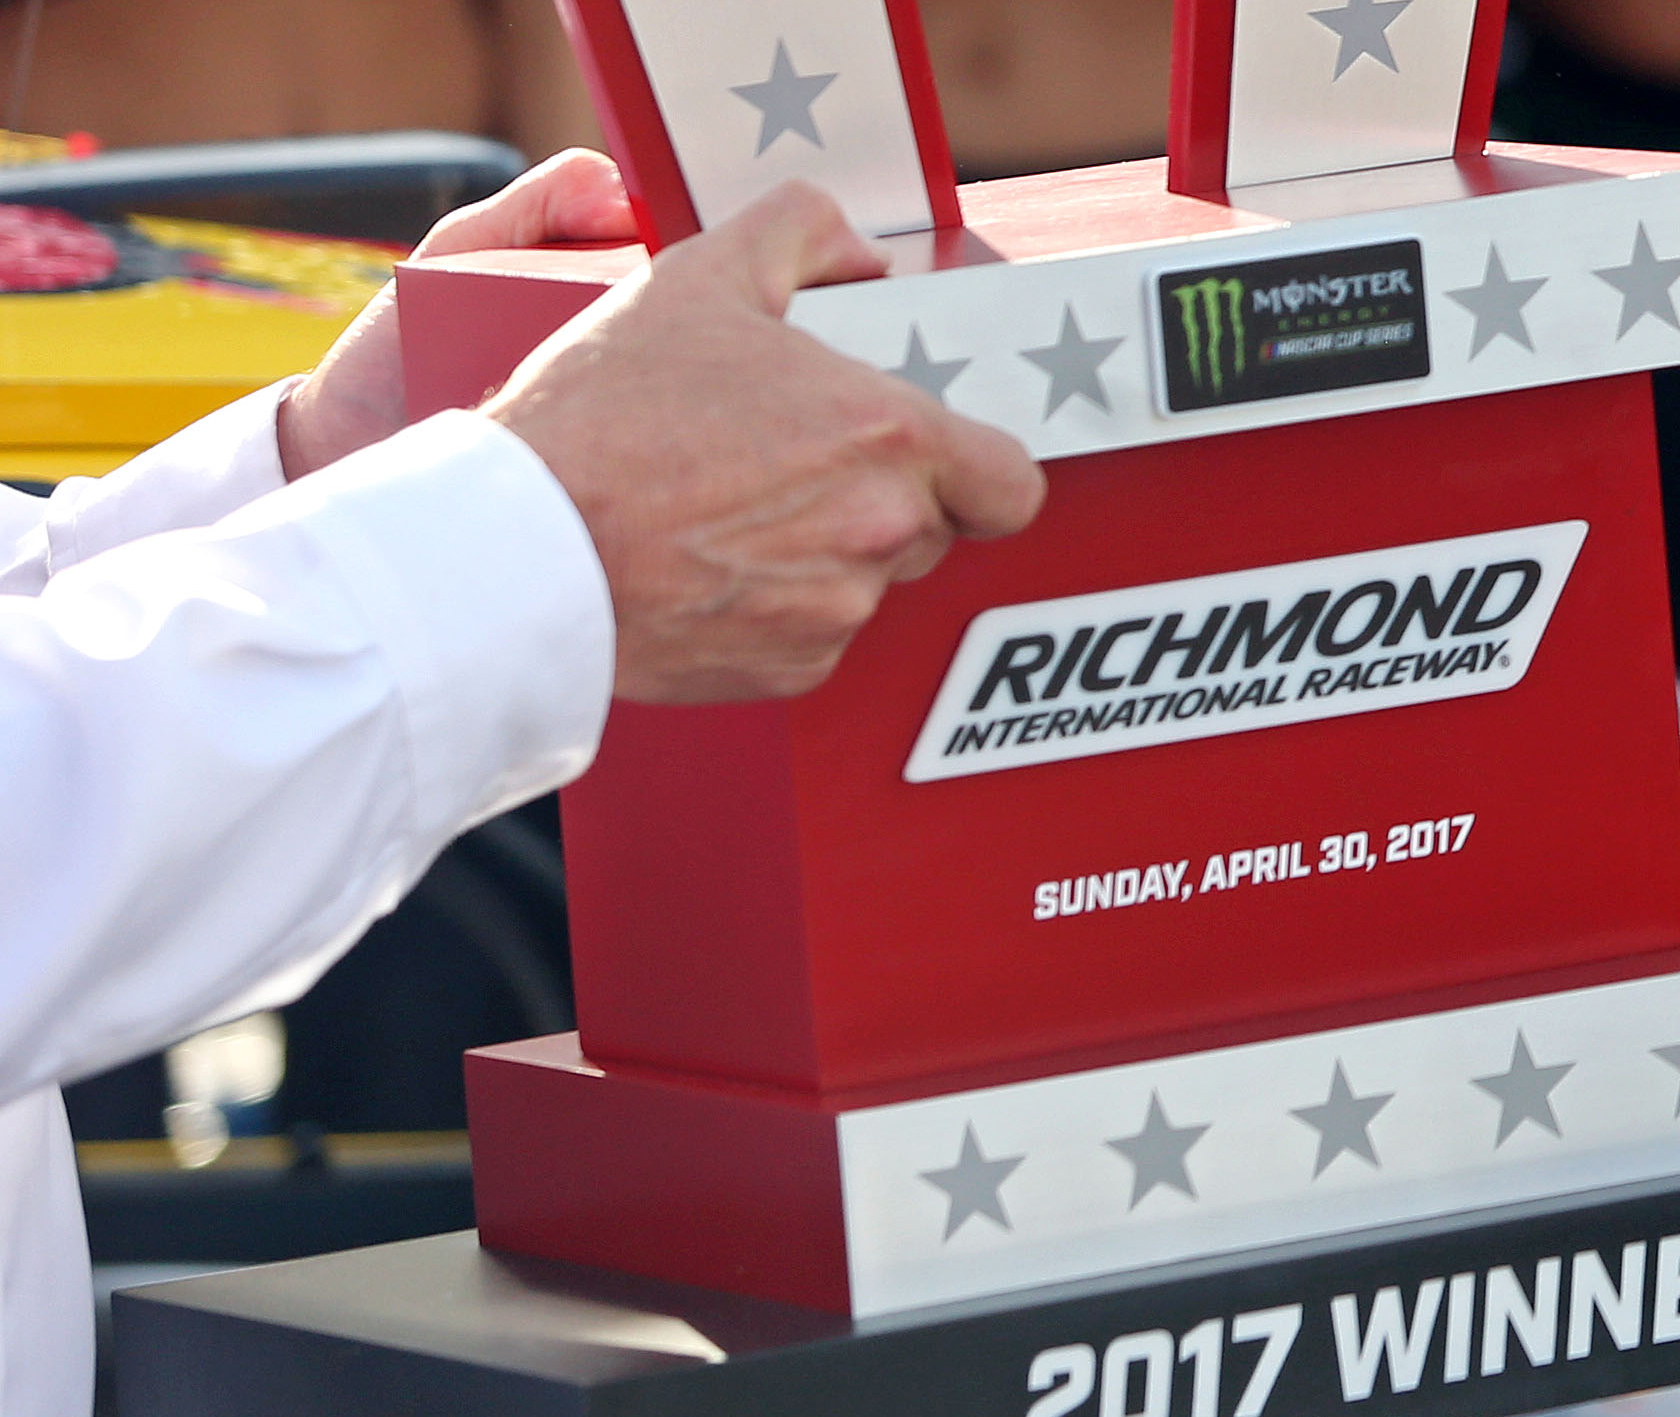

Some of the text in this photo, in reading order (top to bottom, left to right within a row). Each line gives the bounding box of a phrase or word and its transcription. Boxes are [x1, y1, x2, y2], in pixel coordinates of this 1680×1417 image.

[1252, 268, 1414, 315] MONSTER
[968, 558, 1543, 714] RICHMOND
[941, 673, 1290, 756] INTERNATIONAL
[1032, 814, 1475, 921] SUNDAY, APRIL 30, 2017
[1025, 1302, 1304, 1417] 2017
